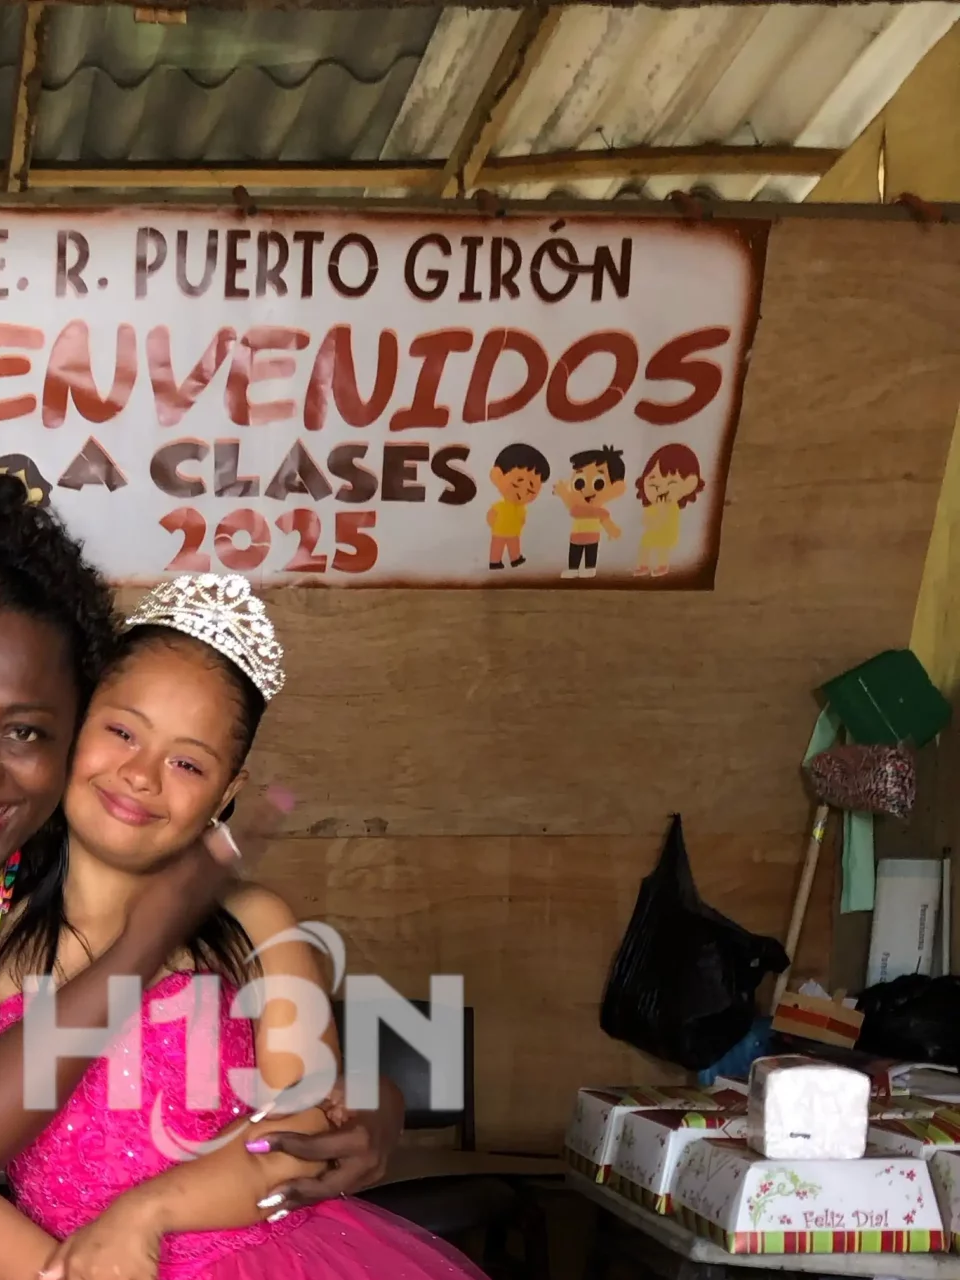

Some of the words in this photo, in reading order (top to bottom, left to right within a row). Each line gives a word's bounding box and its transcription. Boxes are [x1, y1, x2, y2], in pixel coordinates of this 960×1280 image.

[55, 229, 109, 299] R.
[134, 228, 380, 301] PUERTO
[403, 219, 633, 303] GIRÓN
[57, 434, 128, 493] A
[149, 436, 477, 505] CLASES
[158, 507, 379, 573] 2025
[802, 1207, 846, 1229] Feliz
